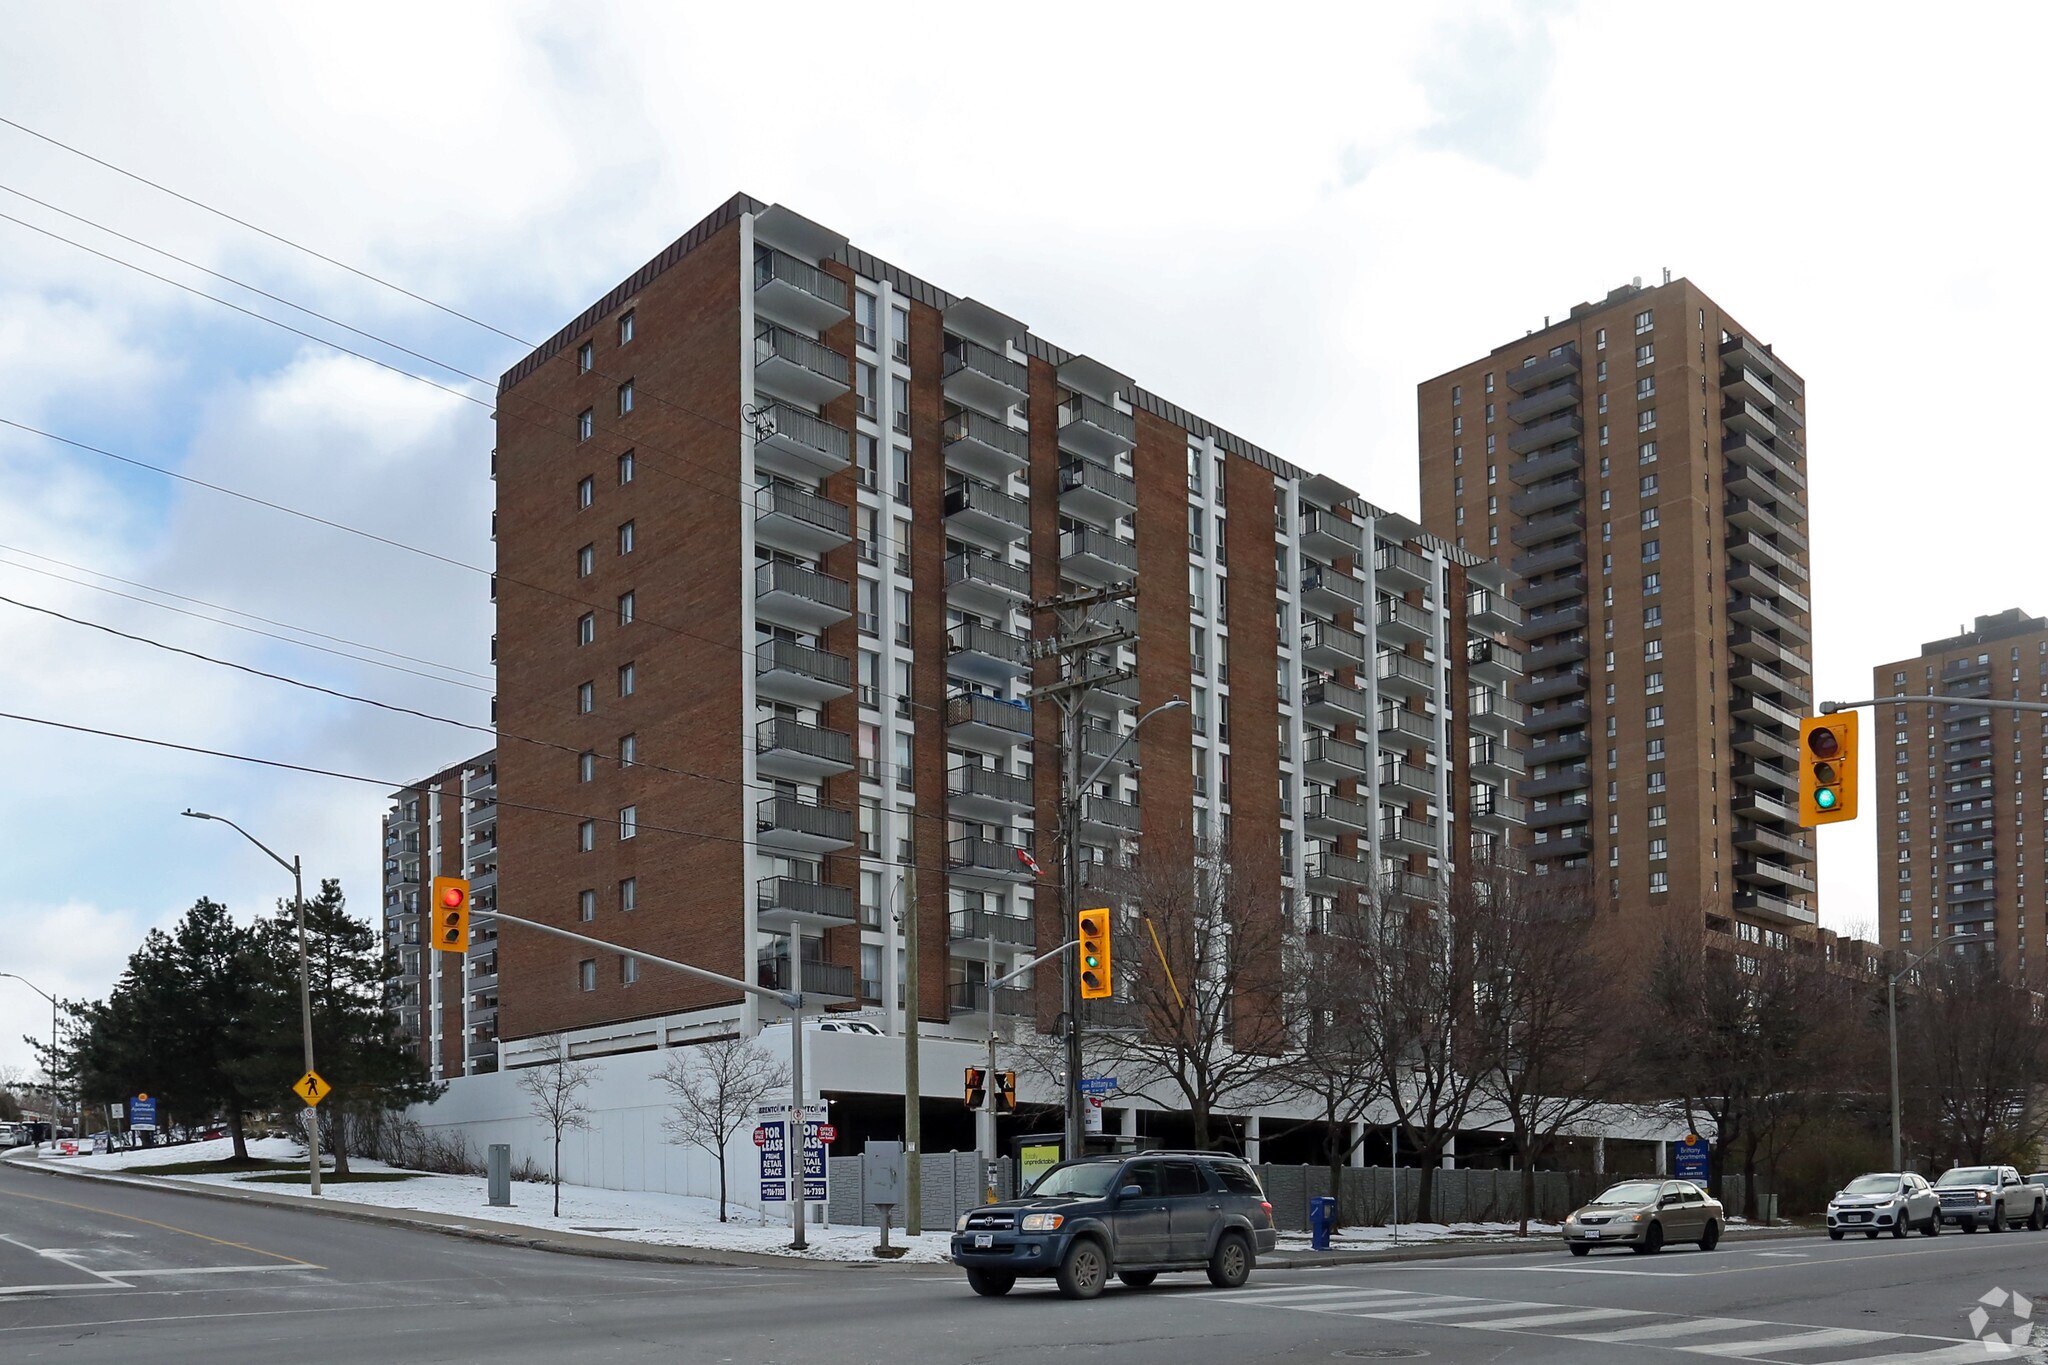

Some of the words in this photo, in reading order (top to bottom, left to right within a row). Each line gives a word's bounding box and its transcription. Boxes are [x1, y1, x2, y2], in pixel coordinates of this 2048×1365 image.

[765, 1126, 780, 1138] FOR
[803, 1124, 818, 1136] OR
[762, 1139, 784, 1151] LEASE
[804, 1137, 823, 1148] ASE
